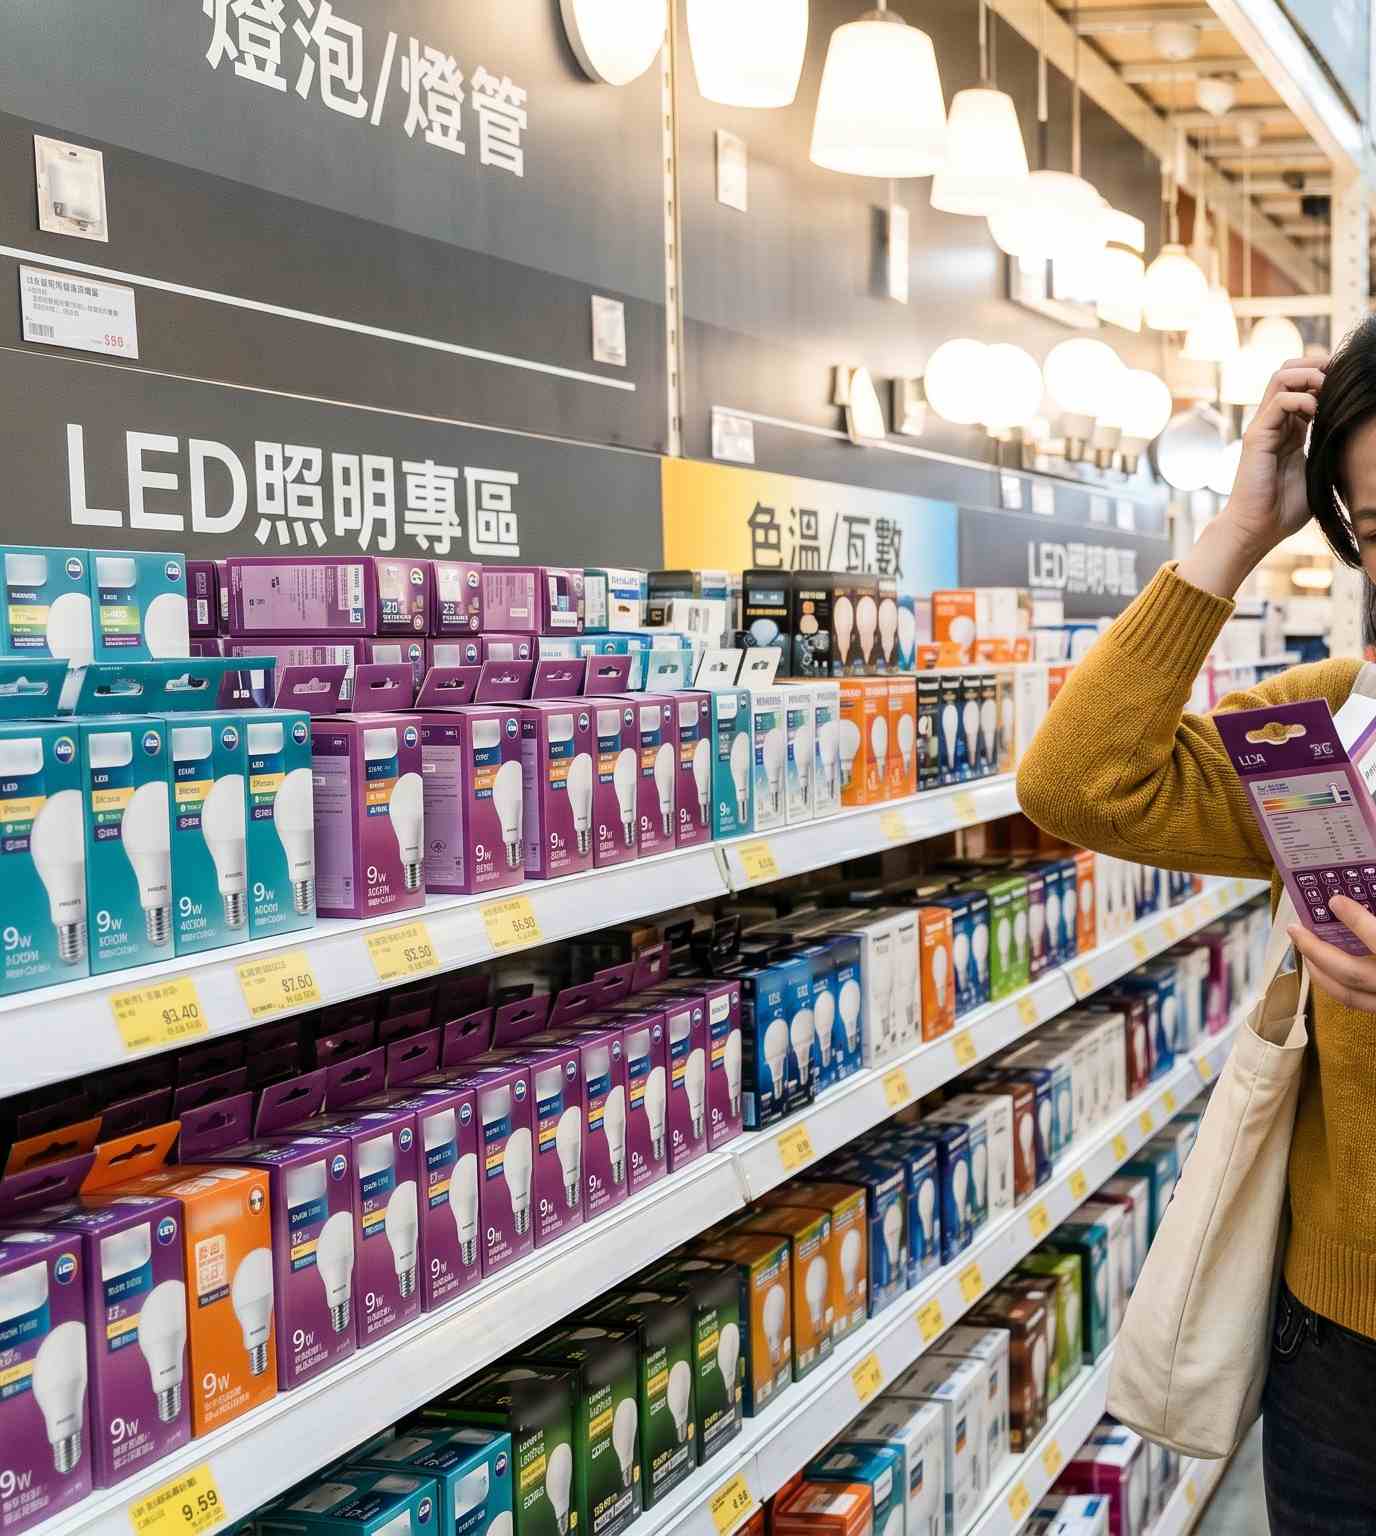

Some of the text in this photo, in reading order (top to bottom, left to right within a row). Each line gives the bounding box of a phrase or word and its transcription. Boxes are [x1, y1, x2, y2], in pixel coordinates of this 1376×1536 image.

[203, 0, 529, 177] 燈泡/燈管
[67, 424, 520, 557] LED照明專區
[747, 501, 904, 578] 色溫/瓦數
[181, 1489, 218, 1521] 9.59
